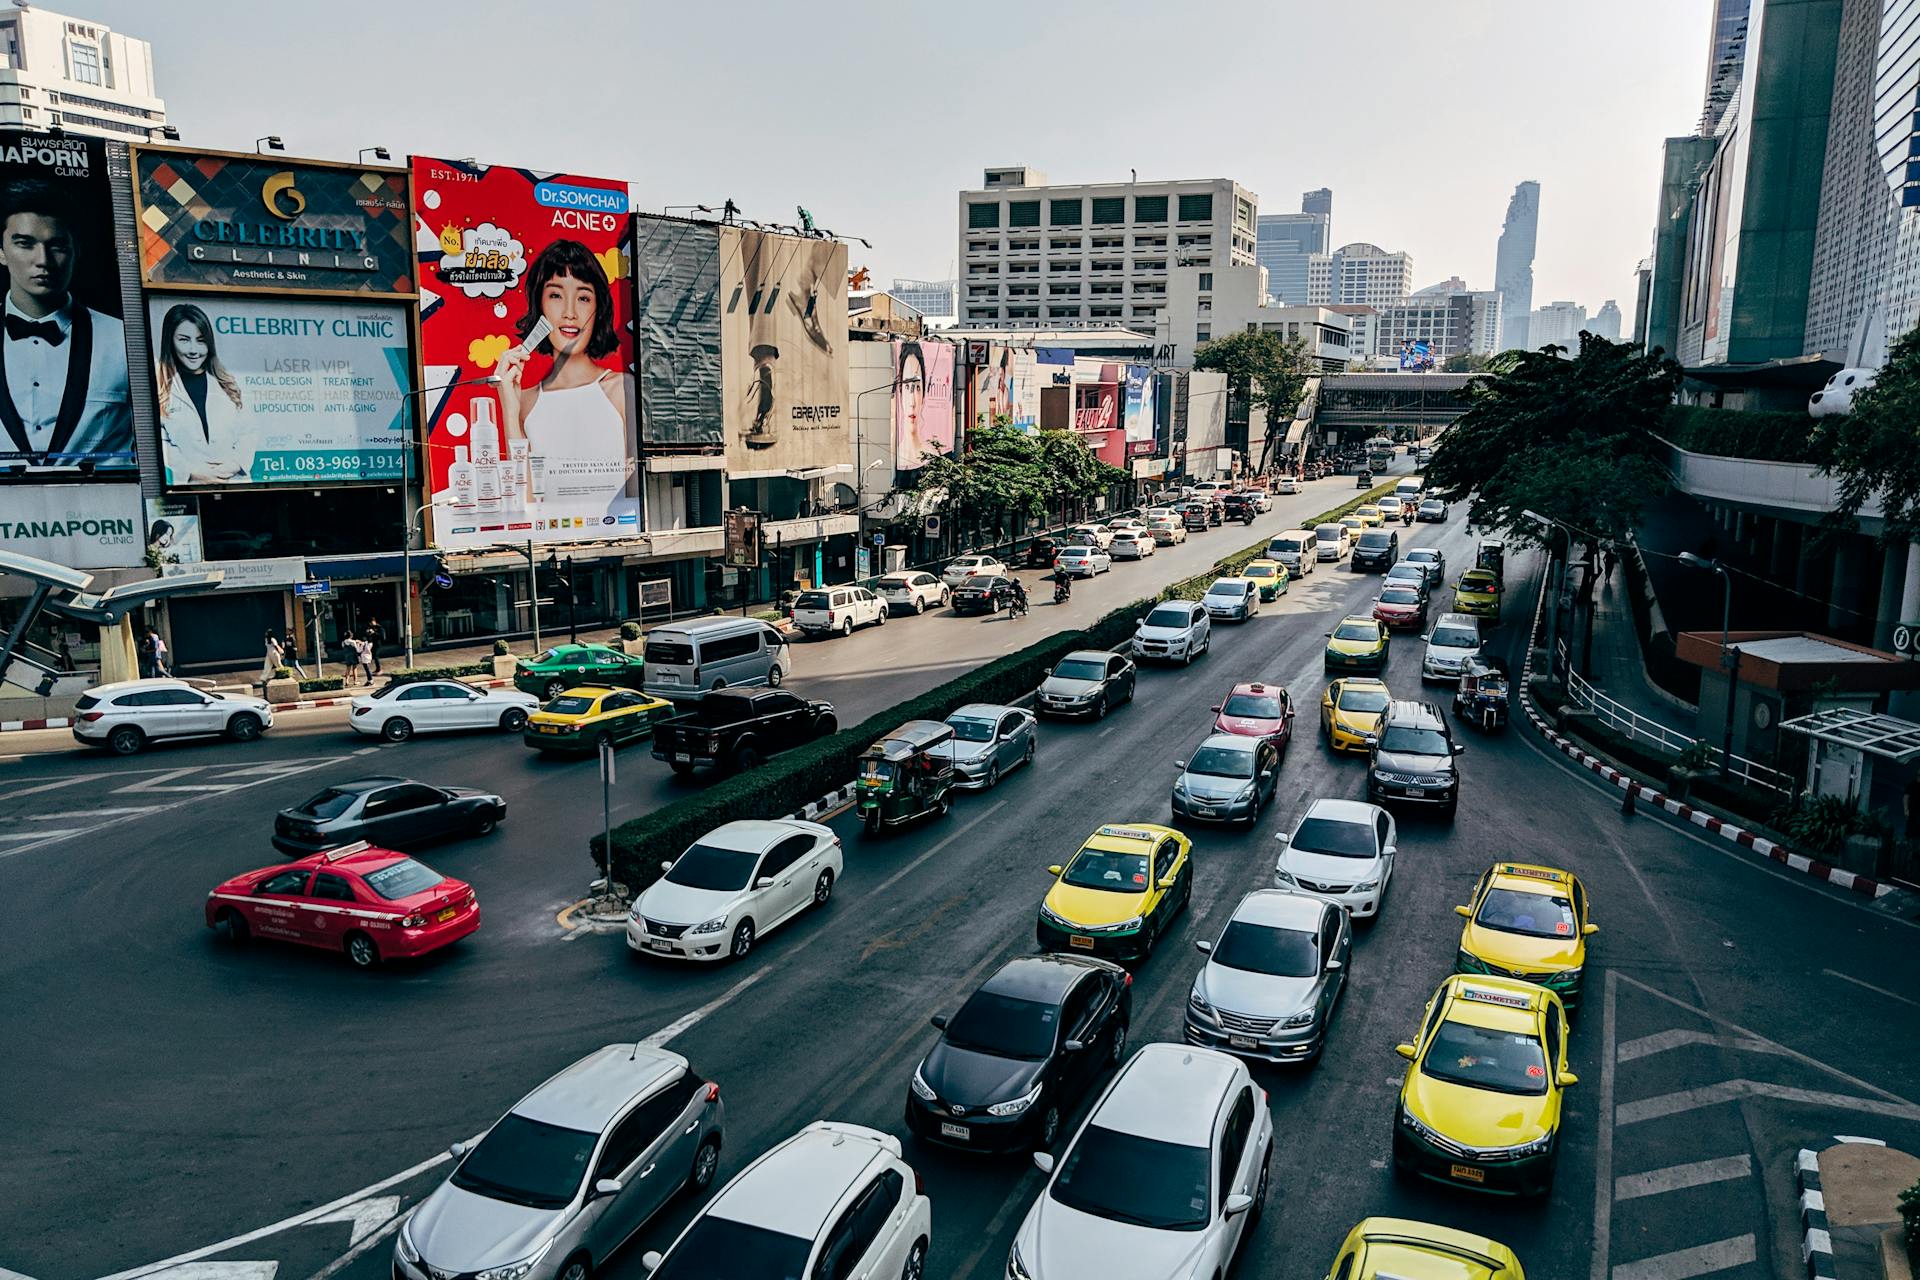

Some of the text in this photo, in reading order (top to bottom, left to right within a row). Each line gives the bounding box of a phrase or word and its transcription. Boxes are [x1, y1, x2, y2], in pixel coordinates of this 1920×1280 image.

[55, 166, 90, 178] CLINIC
[430, 169, 479, 183] EST.1971
[552, 210, 600, 232] ACNE
[193, 220, 366, 250] CELEBRITY
[234, 270, 306, 280] Aesthetic & Skin
[215, 316, 394, 338] CELEBRITY CLINIC
[264, 358, 310, 373] LASER
[245, 376, 312, 386] FACIAL DESIGN
[323, 377, 374, 386] TREATMENT
[252, 390, 313, 400] THERMAGE
[324, 390, 402, 401] HAIR REMOVAL
[254, 404, 314, 413] LIPOSUCTION
[324, 404, 377, 413] ANTI-AGING
[260, 456, 404, 472] Tel. 083-969-1914
[475, 458, 496, 466] ACNE
[0, 518, 133, 539] TANAPORN
[100, 536, 134, 545] CLINIC
[239, 564, 273, 574] beauty
